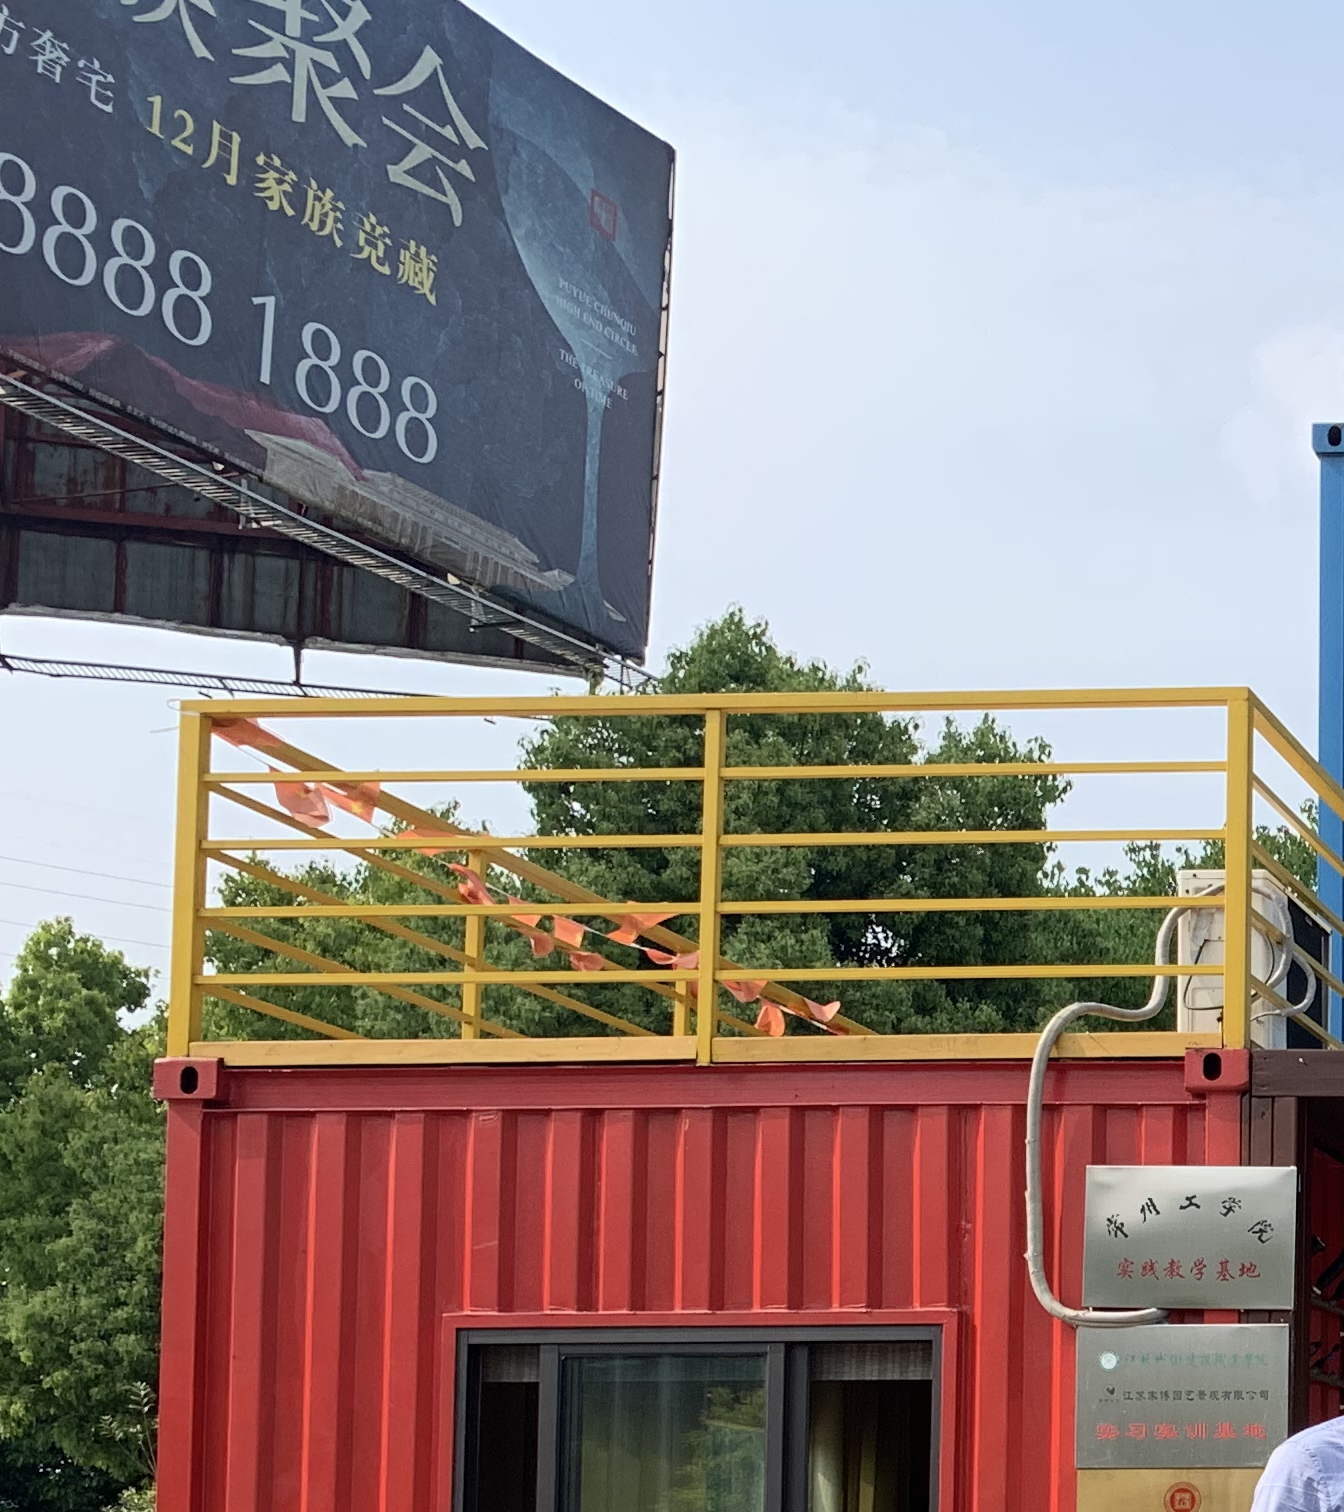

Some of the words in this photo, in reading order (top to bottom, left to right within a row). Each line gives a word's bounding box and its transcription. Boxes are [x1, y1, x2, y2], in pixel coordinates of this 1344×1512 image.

[558, 277, 594, 309] PUYUE
[582, 310, 603, 334] END
[603, 325, 639, 356] CIRCLE
[558, 348, 579, 369] THE
[250, 294, 438, 465] 1888
[1116, 1257, 1261, 1282] 实践教学基地
